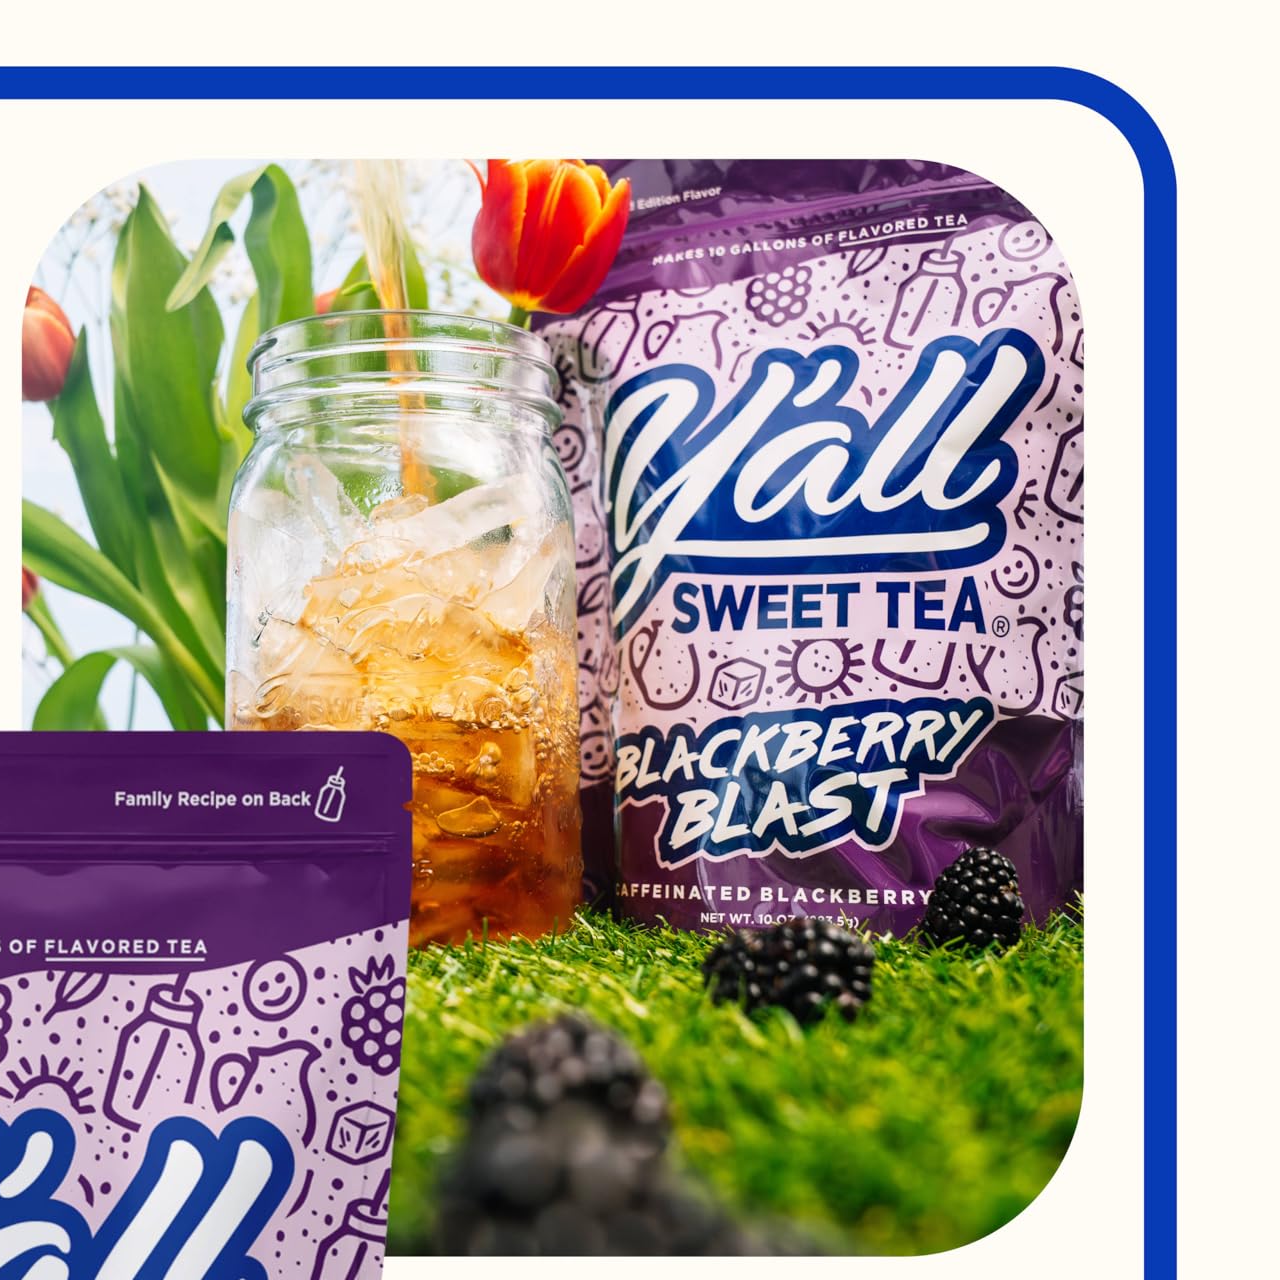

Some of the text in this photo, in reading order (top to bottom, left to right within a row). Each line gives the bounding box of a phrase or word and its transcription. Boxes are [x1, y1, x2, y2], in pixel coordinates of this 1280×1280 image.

[637, 194, 680, 210] Edition
[683, 186, 722, 201] Flavor
[652, 214, 968, 265] MAKES 10 GALLONS OF FLAVORED TEA
[604, 344, 1027, 624] Y'all
[672, 580, 861, 635] SWEET
[615, 708, 984, 793] BLACKBERRY
[114, 790, 311, 809] Family Recipe on Back
[669, 767, 908, 849] BLAST
[760, 886, 935, 905] BLACKBERRY
[701, 912, 725, 923] NET
[730, 913, 754, 924] WT.
[759, 914, 772, 924] 10
[8, 939, 37, 954] OF
[45, 939, 160, 954] FLAVORED
[167, 939, 207, 954] TEA
